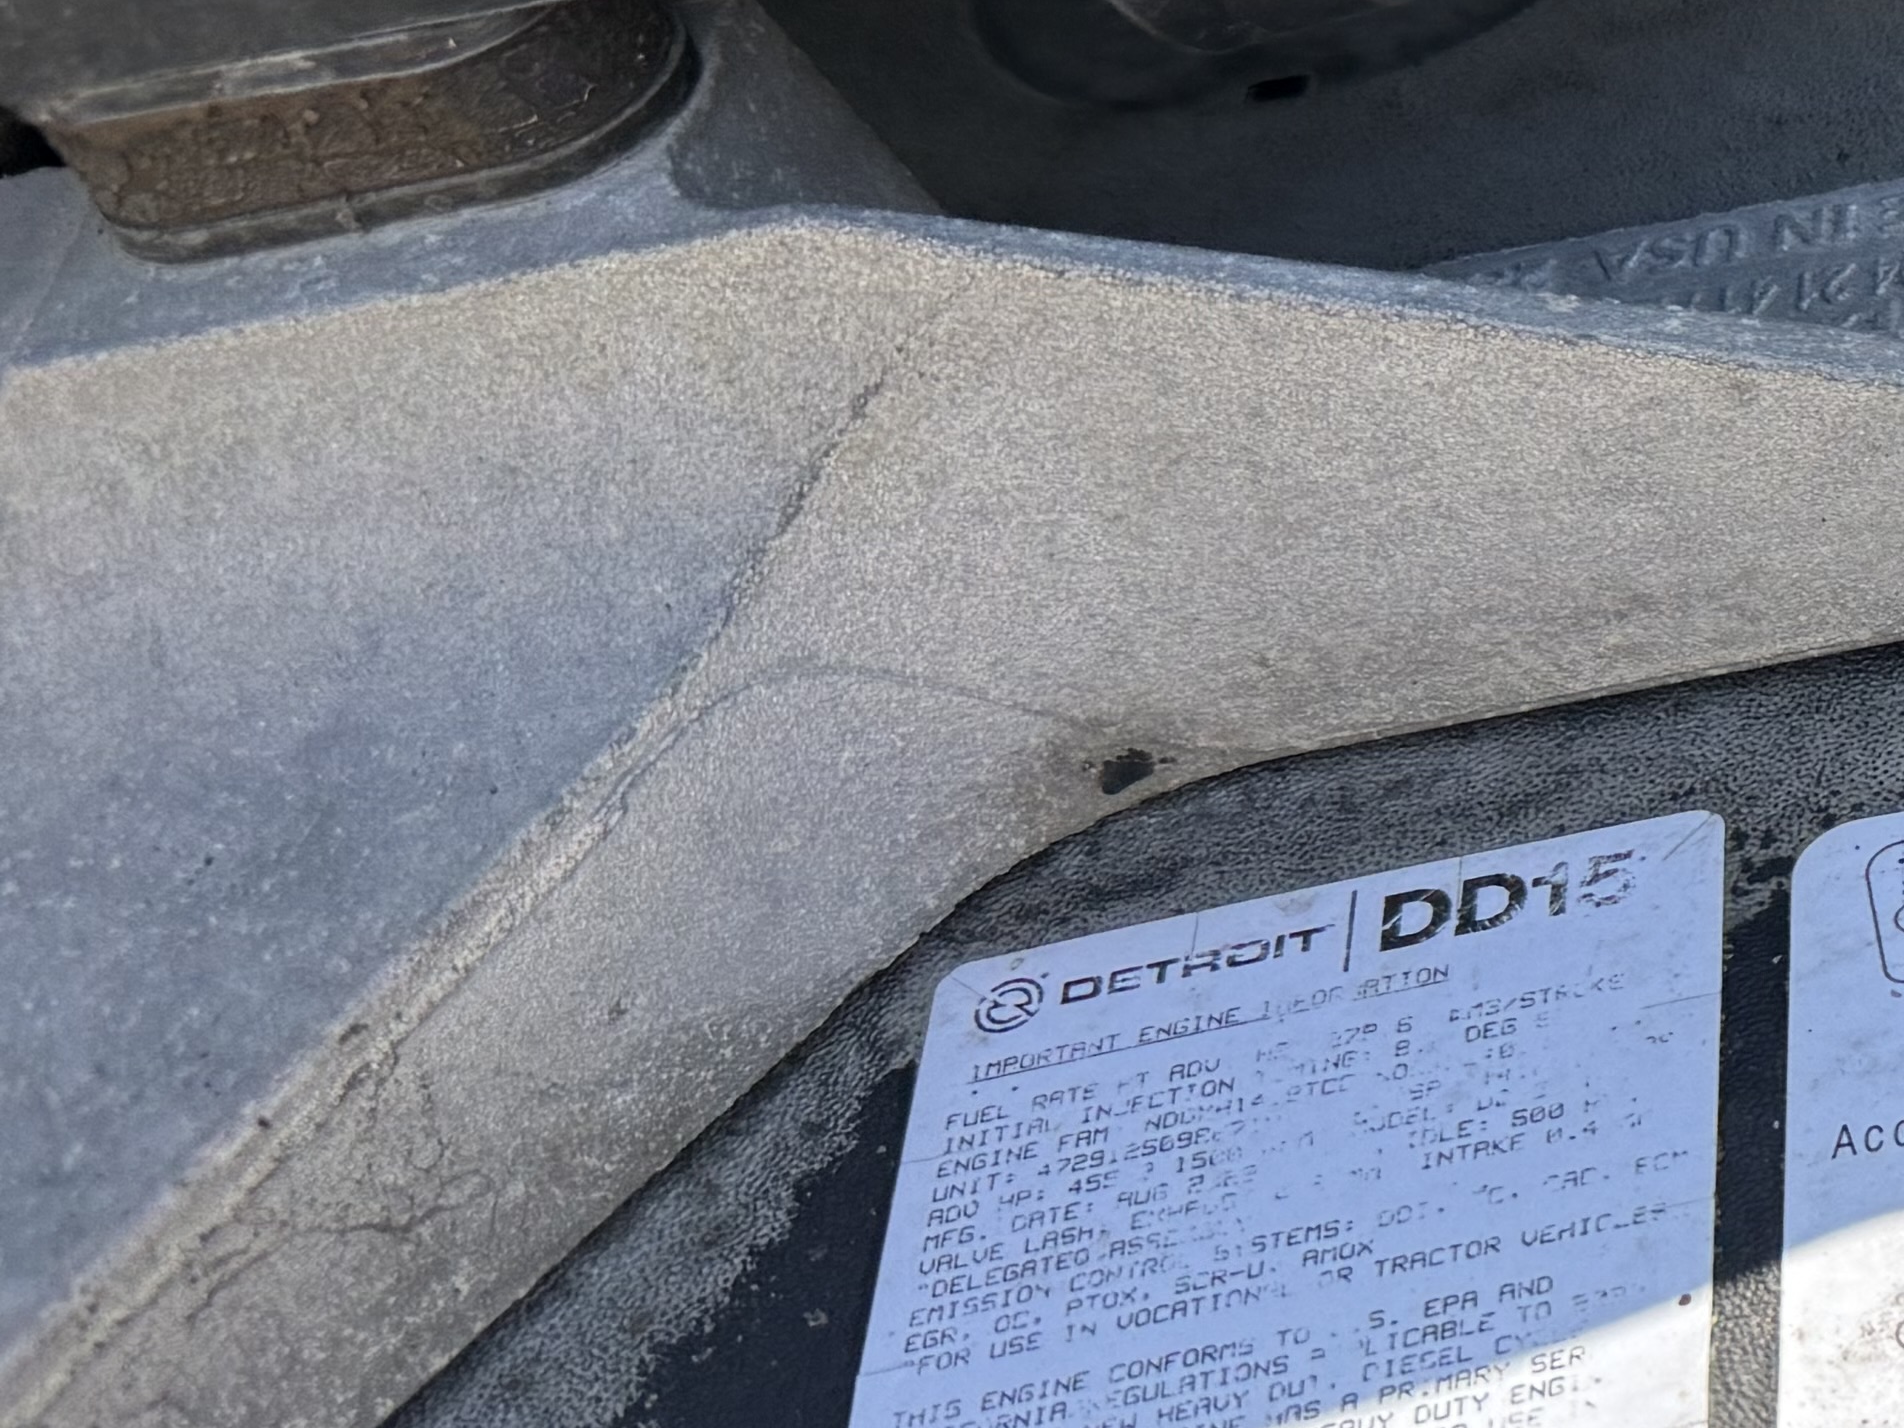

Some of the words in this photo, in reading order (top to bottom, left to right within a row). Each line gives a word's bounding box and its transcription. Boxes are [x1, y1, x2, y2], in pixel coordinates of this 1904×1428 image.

[1059, 925, 1329, 1004] DETROIT
[1379, 843, 1639, 953] DD15
[971, 1032, 1121, 1079] IMPORTANT
[1137, 1005, 1241, 1044] ENGINE
[1464, 1016, 1518, 1044] DEG
[943, 1100, 1011, 1131] FUEL
[1030, 1082, 1099, 1113] RATE
[921, 1221, 989, 1252] MFG.
[1010, 1199, 1093, 1233] DATE:
[1511, 1099, 1564, 1127] 500
[935, 1140, 1040, 1178] ENGINE
[930, 1169, 1016, 1203] UNIT:
[1068, 1250, 1192, 1294] CONTRO
[989, 1331, 1042, 1359] USE
[1373, 1233, 1501, 1277] TRACTOR
[980, 1370, 1090, 1411] ENGINE
[1107, 1336, 1255, 1384] CONFORMS
[1423, 1288, 1479, 1318] EPA
[1497, 1272, 1554, 1302] AND
[1093, 1354, 1289, 1413] EGULATIONS
[1339, 1391, 1359, 1414] A
[1413, 1389, 1490, 1424] DUTY
[1155, 1389, 1246, 1427] HEAVY
